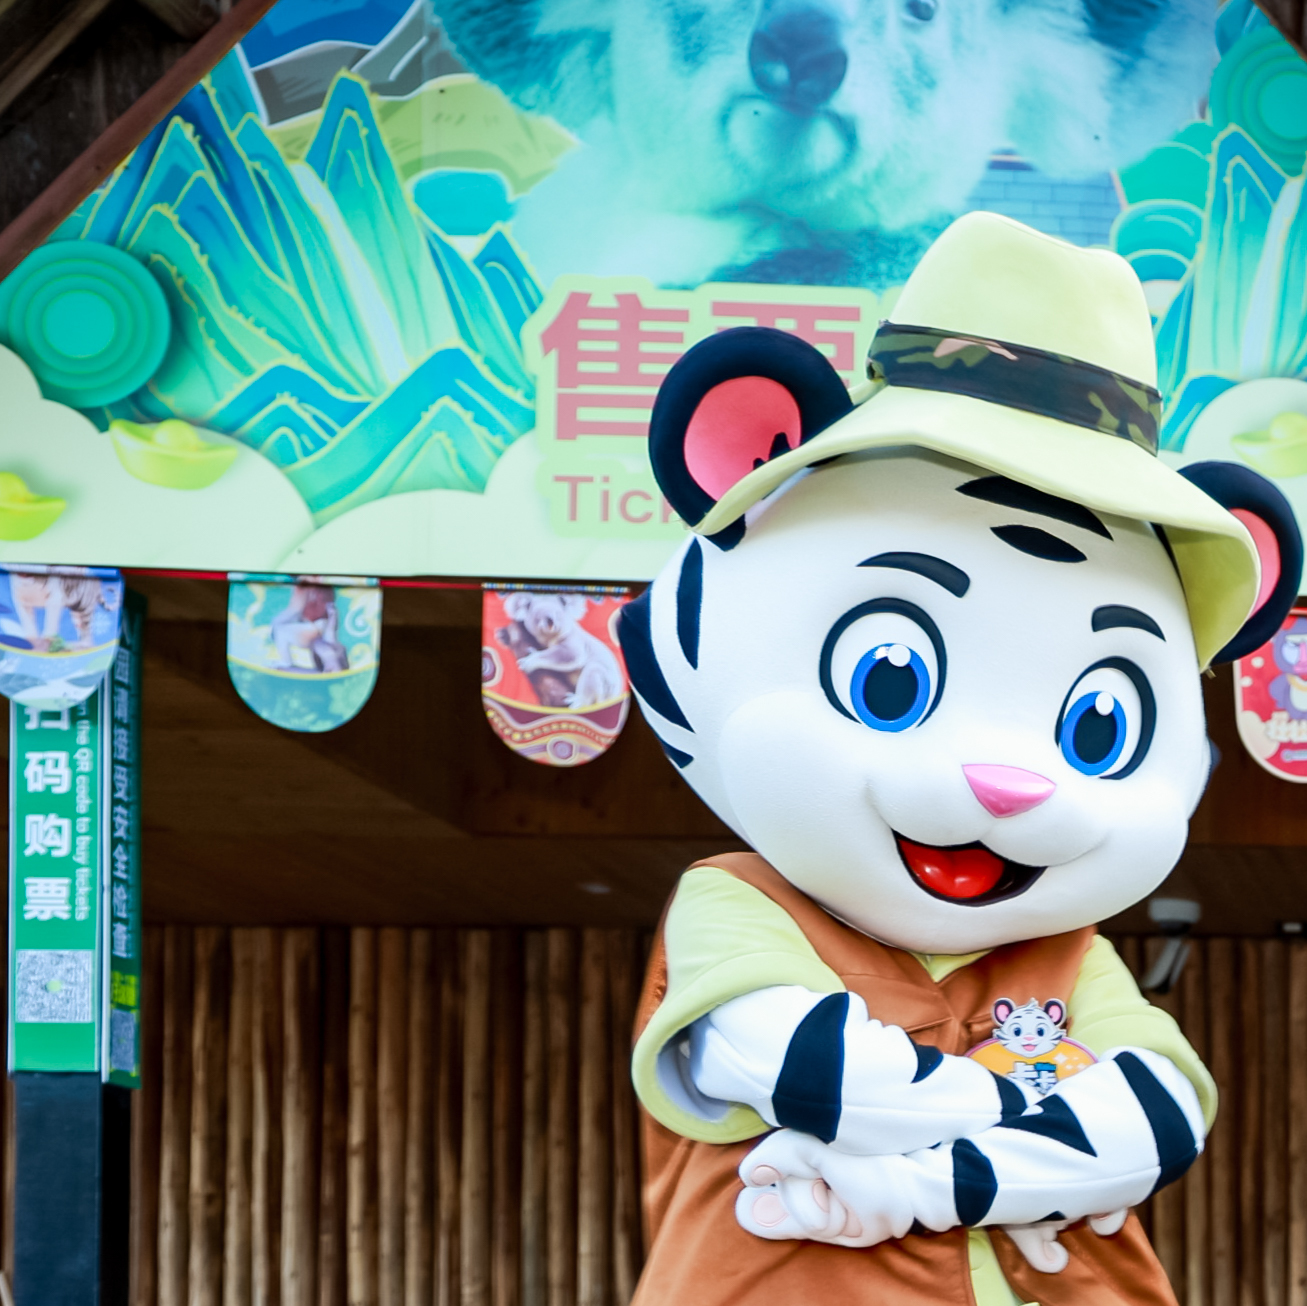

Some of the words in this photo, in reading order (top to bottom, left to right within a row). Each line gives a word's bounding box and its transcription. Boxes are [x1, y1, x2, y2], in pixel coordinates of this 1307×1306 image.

[73, 747, 93, 774] QR
[76, 774, 92, 814] code
[76, 817, 91, 833] to
[73, 836, 92, 865] buy
[75, 867, 92, 921] tickets
